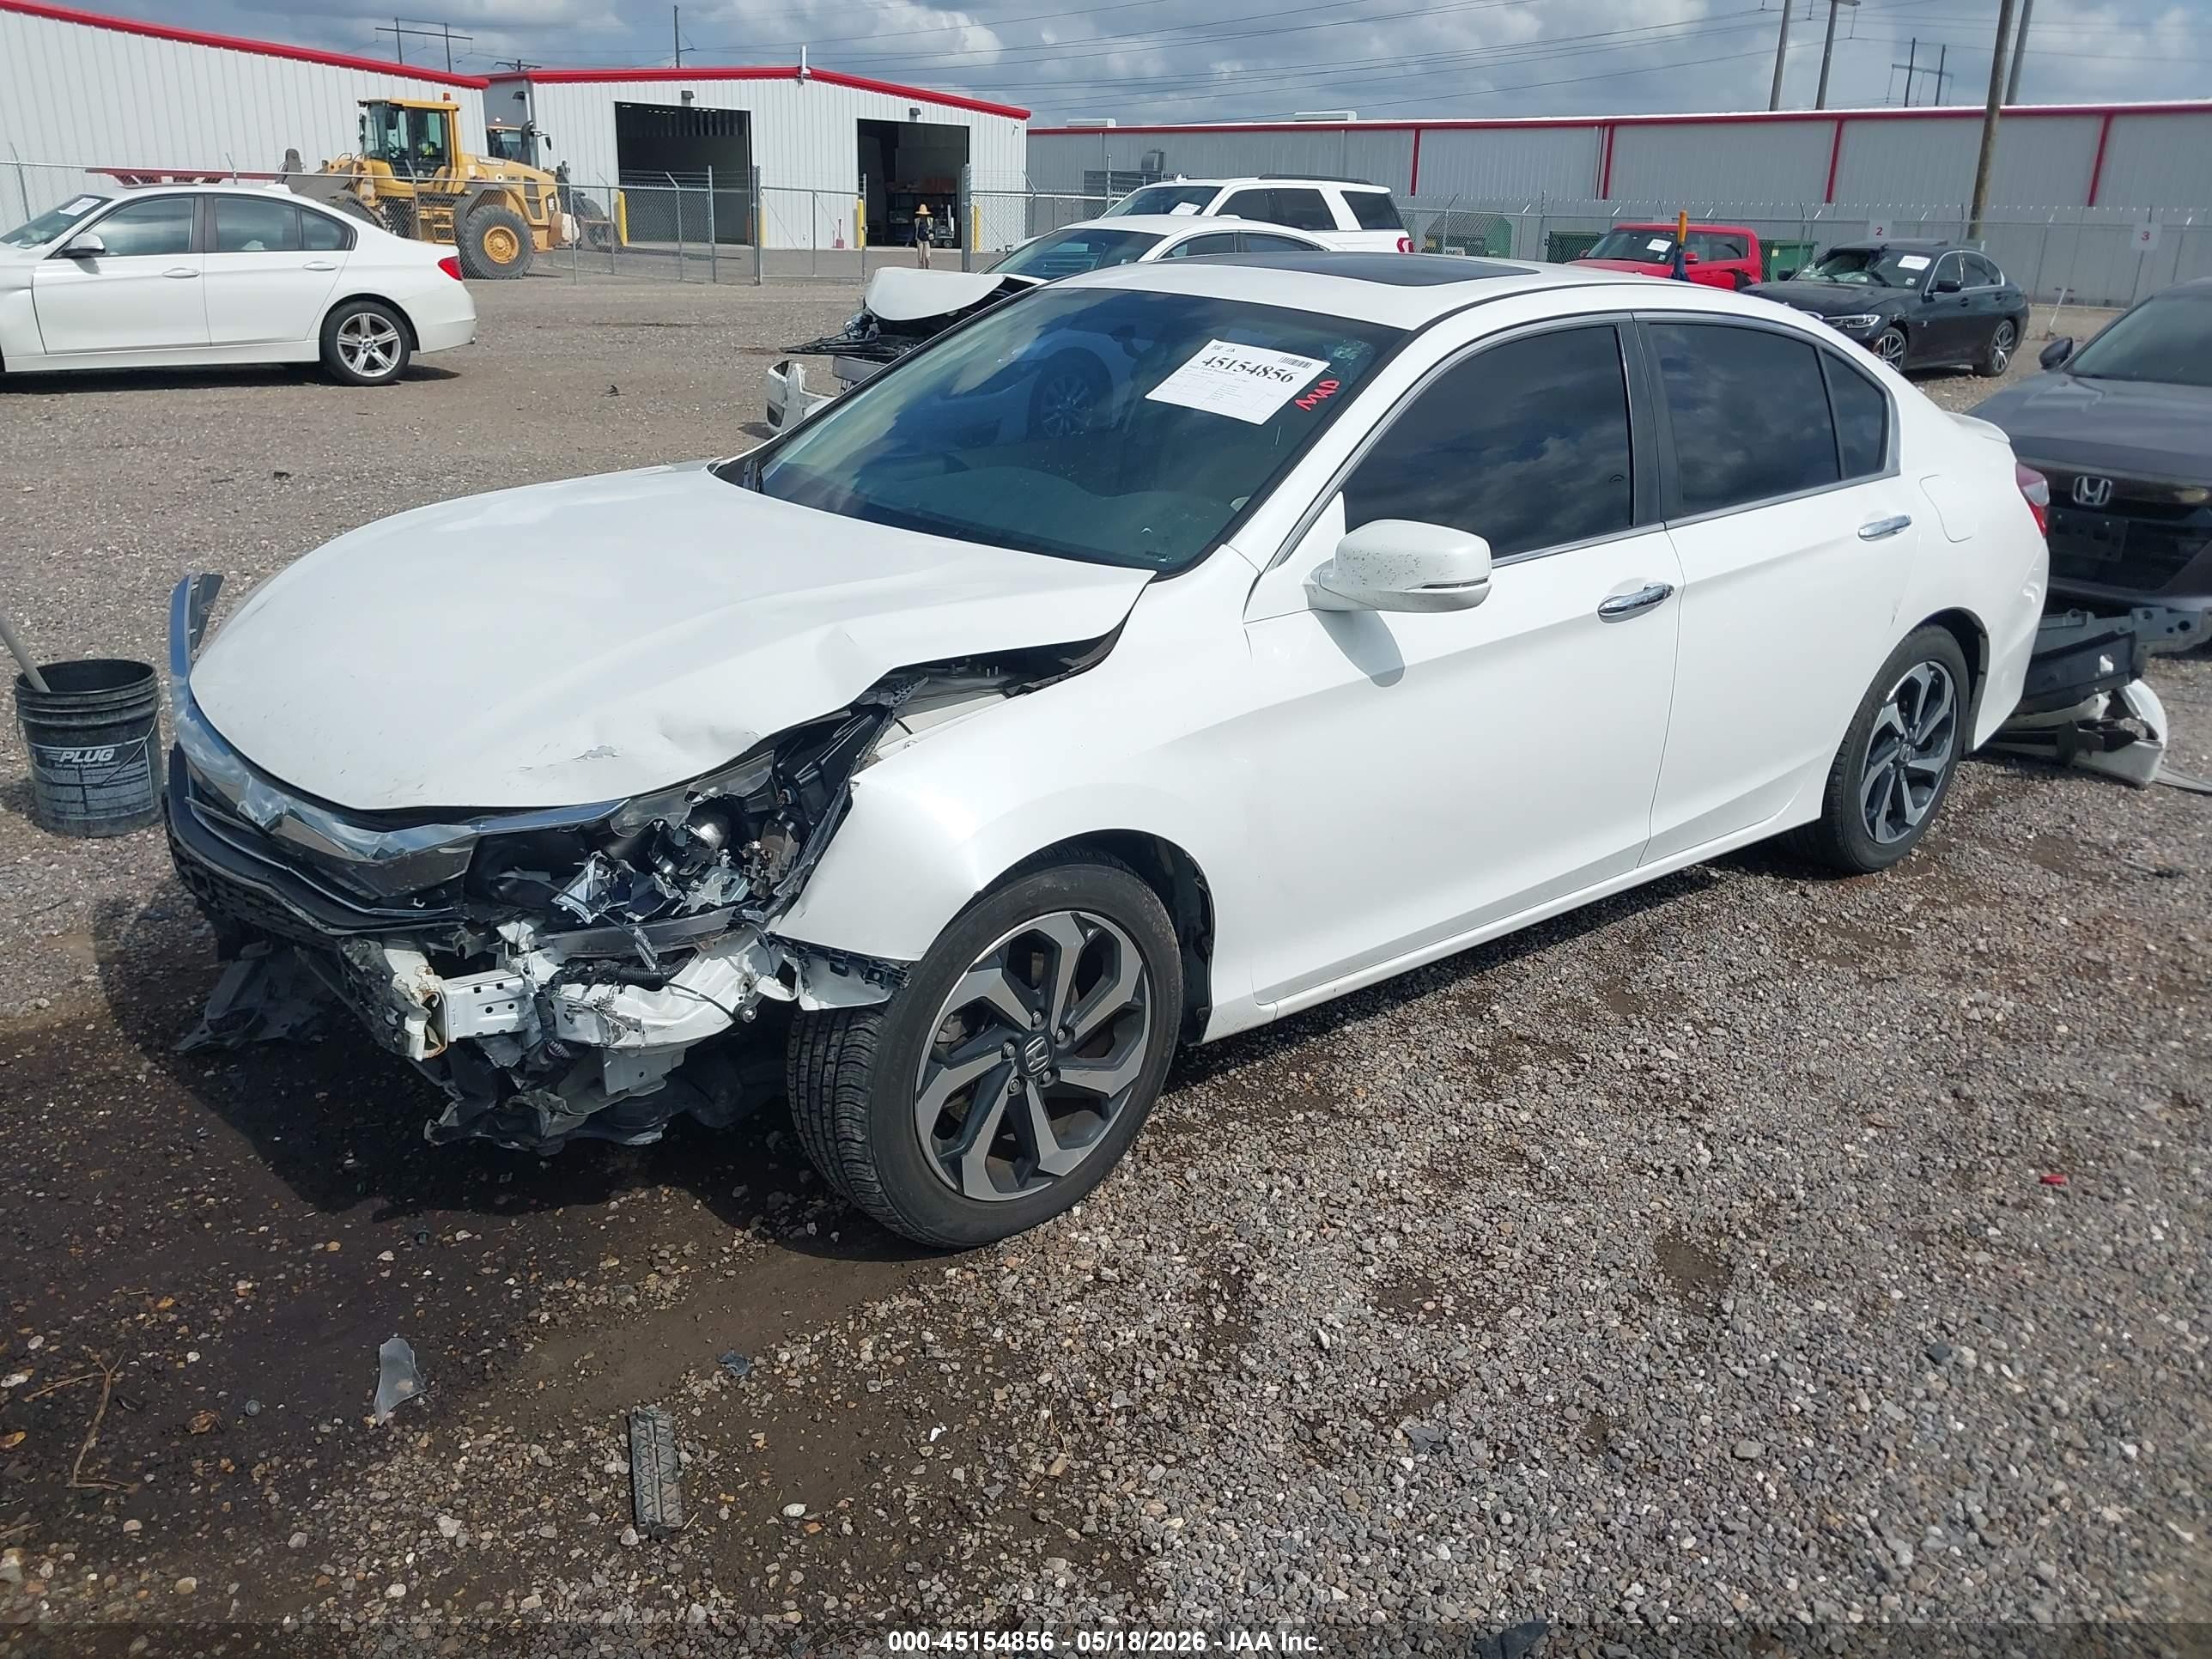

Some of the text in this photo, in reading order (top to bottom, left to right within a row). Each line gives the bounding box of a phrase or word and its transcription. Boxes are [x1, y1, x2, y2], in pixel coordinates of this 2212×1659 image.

[1875, 227, 1883, 236] 2
[2141, 231, 2150, 240] 3
[1202, 356, 1299, 384] 45154856
[59, 748, 115, 763] PLUG
